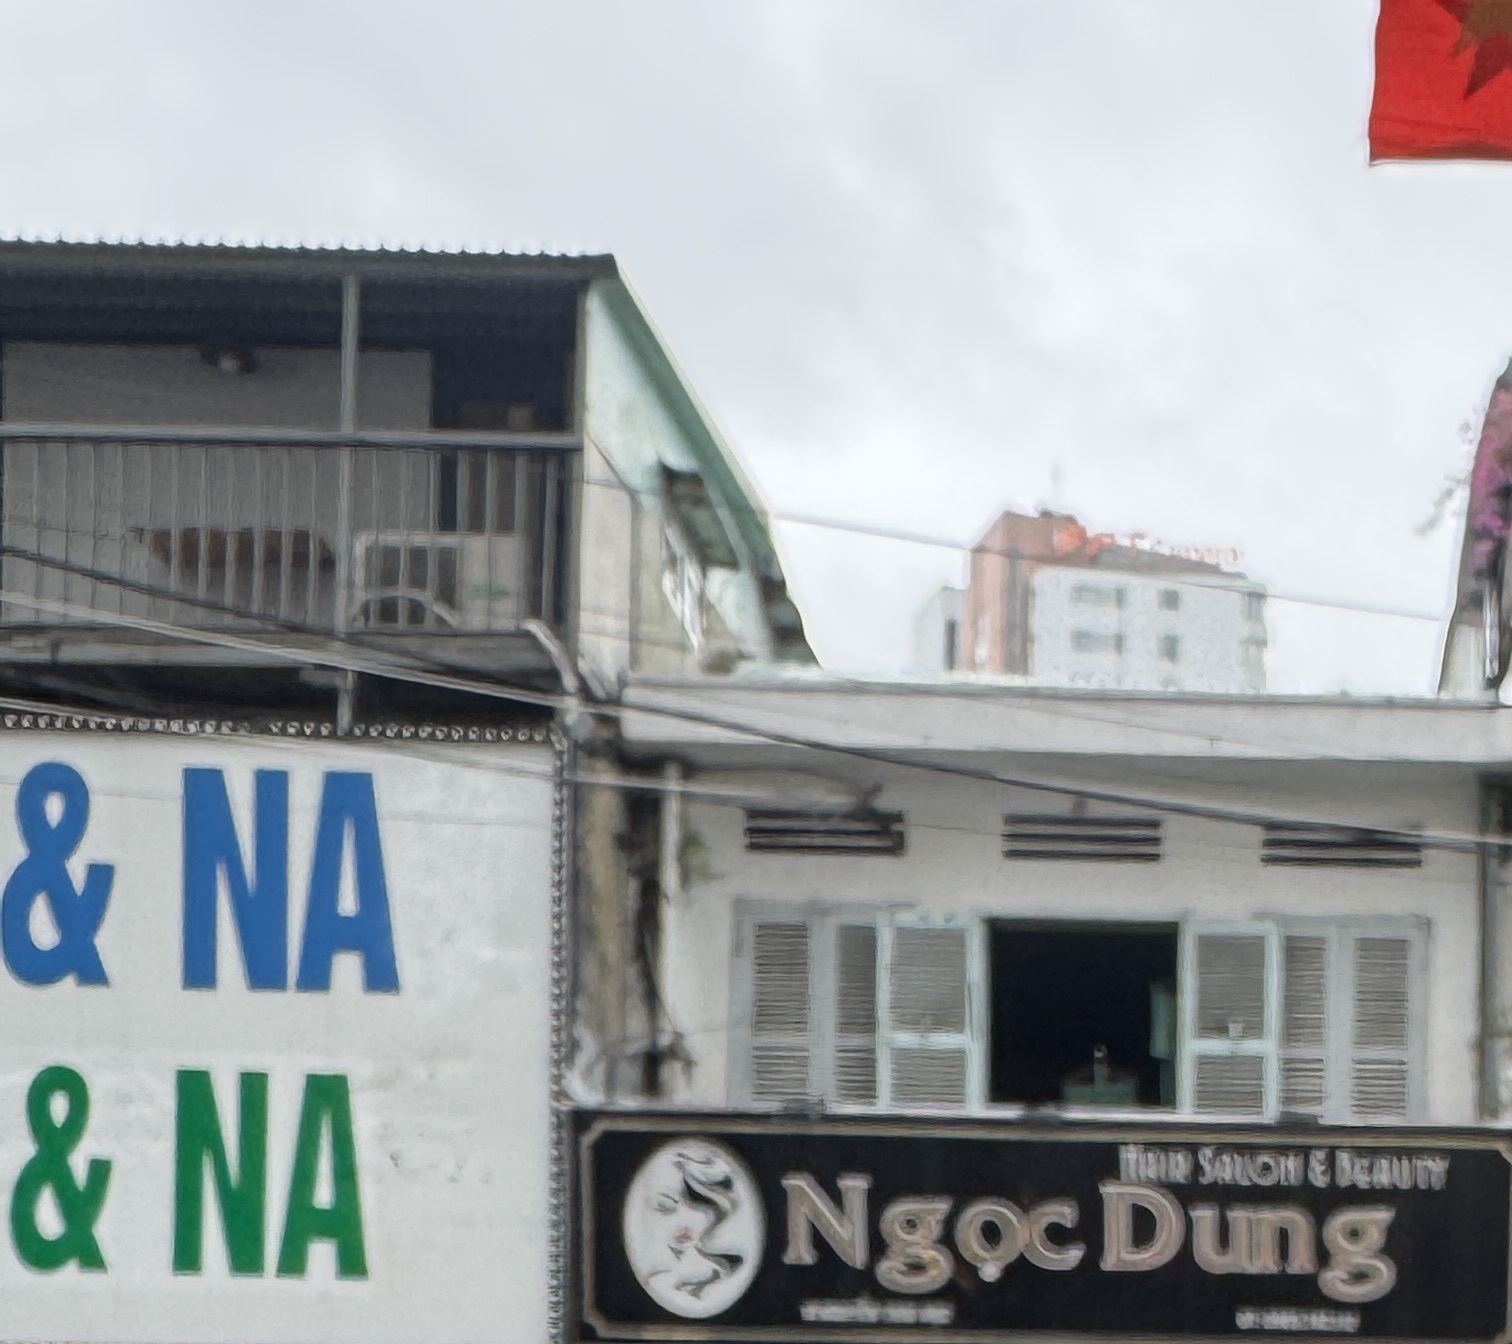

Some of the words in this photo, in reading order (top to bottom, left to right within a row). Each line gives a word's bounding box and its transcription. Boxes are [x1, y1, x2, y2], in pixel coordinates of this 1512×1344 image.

[2, 762, 115, 987] &
[182, 767, 400, 994] NA
[10, 1065, 112, 1273] &
[172, 1069, 369, 1280] NA
[781, 1171, 1087, 1295] Ngọc
[1098, 1180, 1398, 1303] Dung
